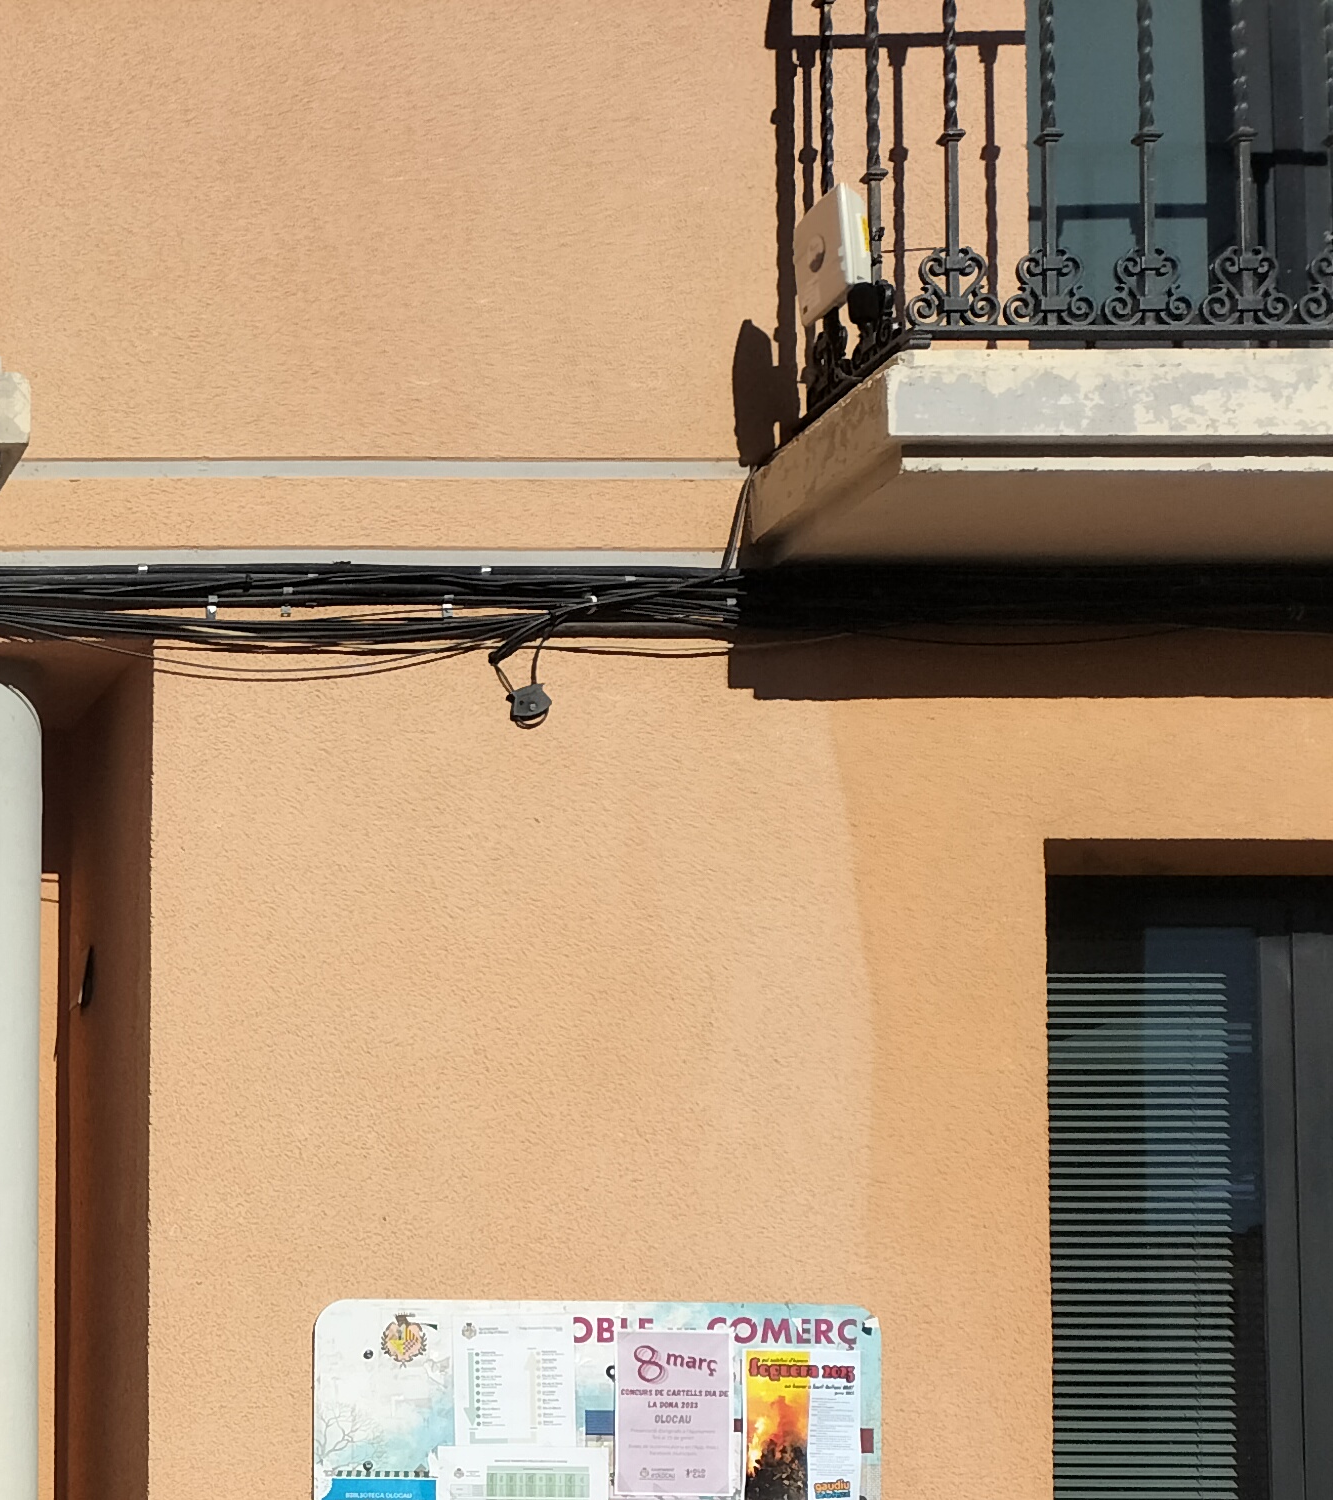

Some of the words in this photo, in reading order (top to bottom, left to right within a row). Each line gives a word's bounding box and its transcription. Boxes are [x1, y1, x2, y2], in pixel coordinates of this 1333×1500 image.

[633, 1344, 665, 1383] 8
[666, 1352, 718, 1377] març
[621, 1388, 653, 1396] CONCURS
[655, 1389, 665, 1397] DE
[667, 1389, 703, 1397] CARTELLS
[719, 1390, 729, 1398] DE
[659, 1401, 679, 1409] DONA
[654, 1414, 692, 1424] OLOCAU
